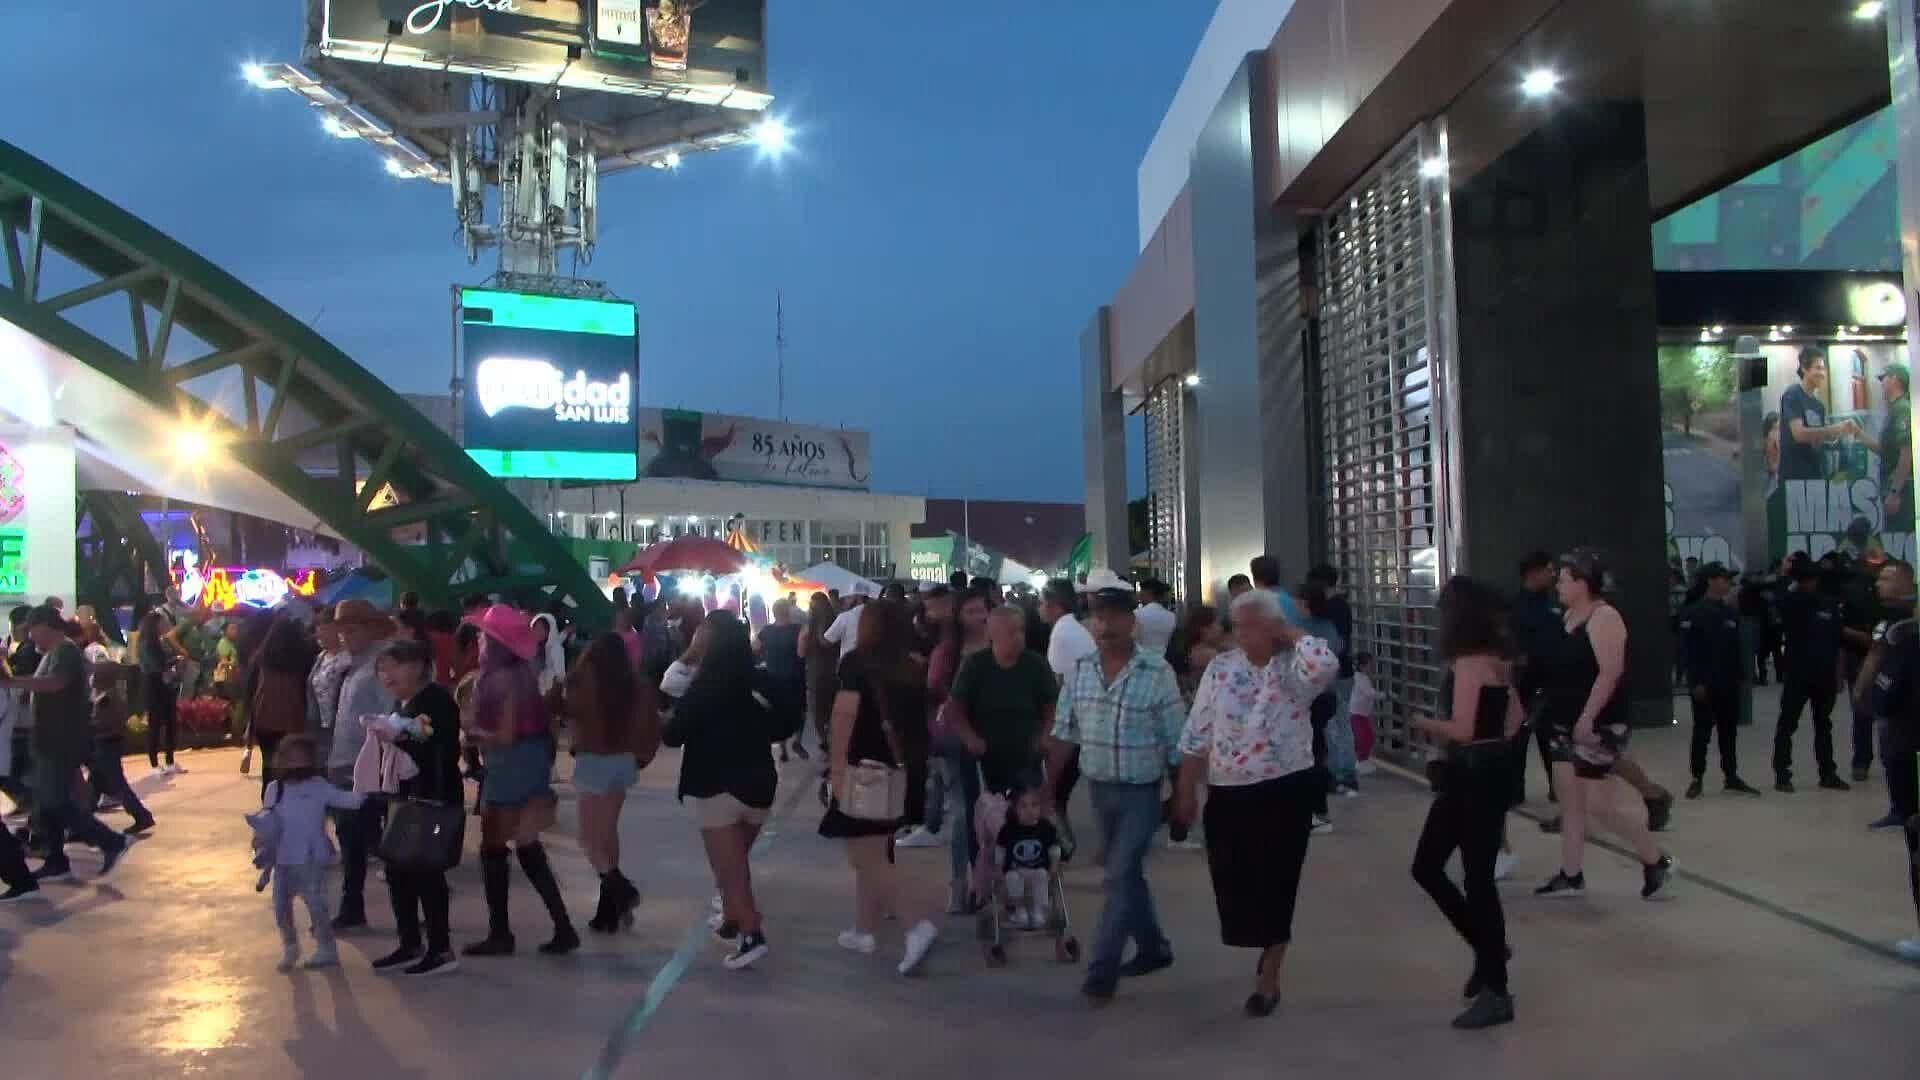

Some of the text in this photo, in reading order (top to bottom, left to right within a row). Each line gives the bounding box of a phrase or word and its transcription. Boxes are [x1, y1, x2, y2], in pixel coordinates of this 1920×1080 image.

[555, 405, 629, 423] SAN LUIS
[752, 431, 826, 460] 85 AÑOS
